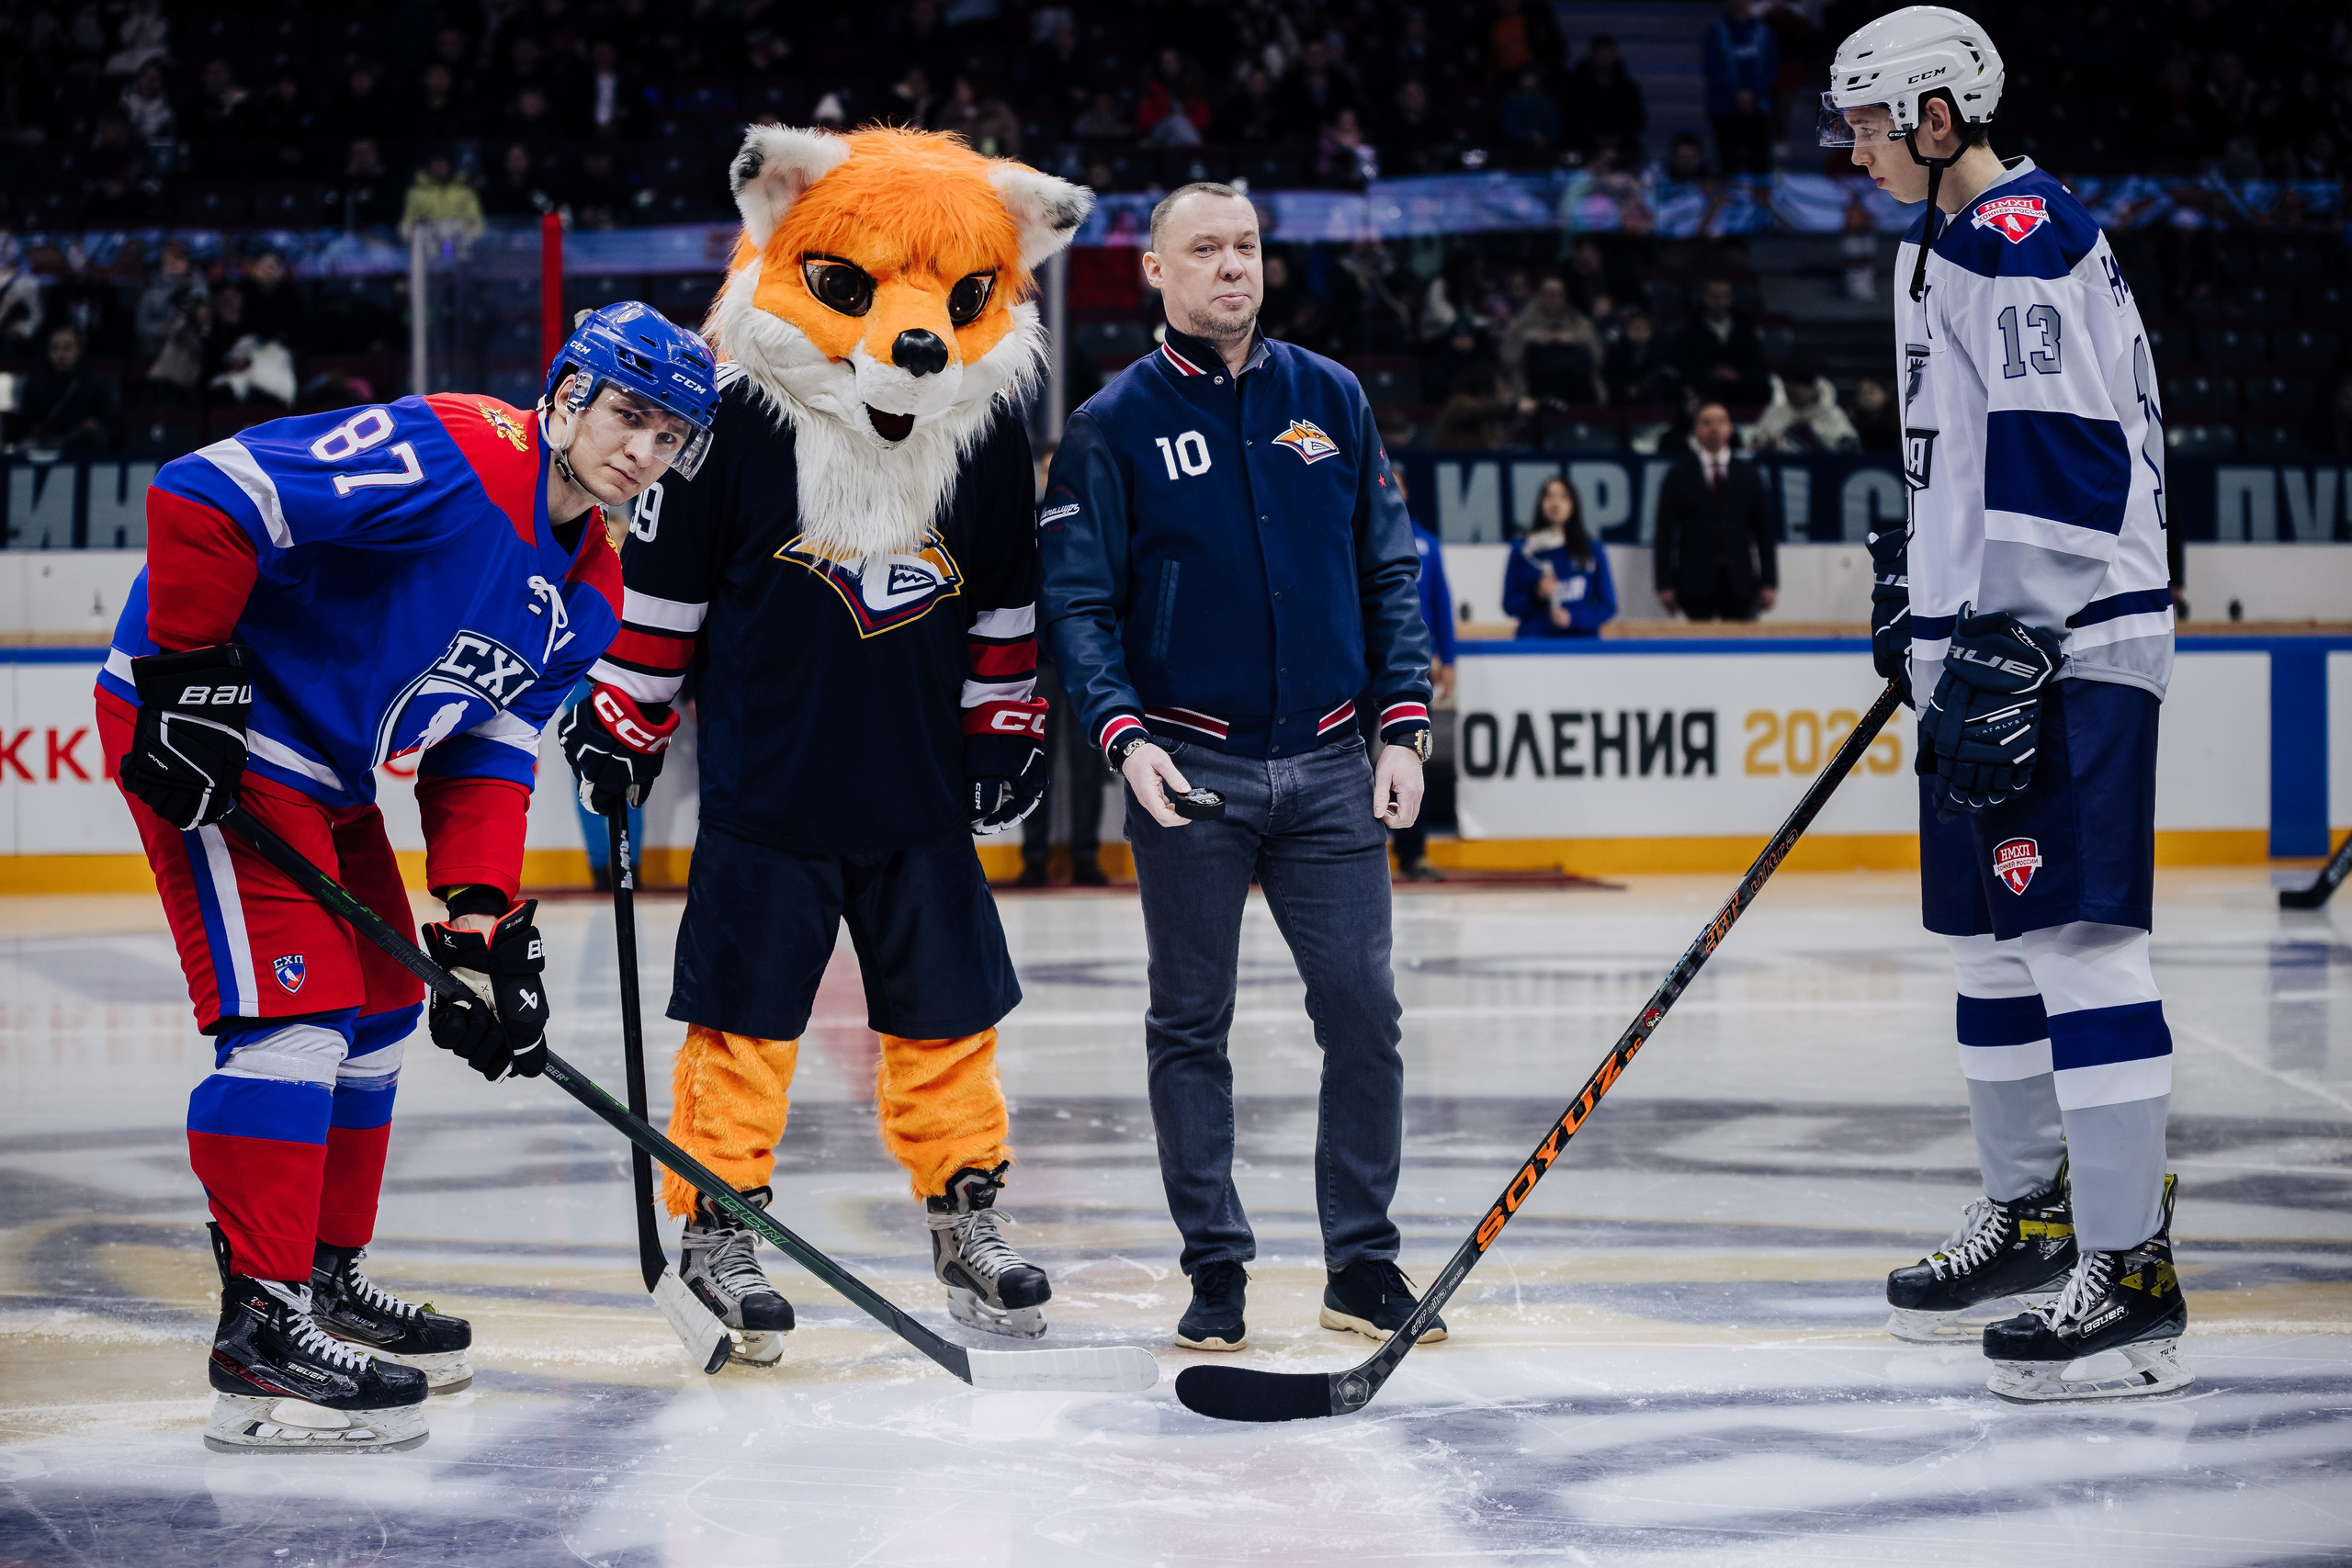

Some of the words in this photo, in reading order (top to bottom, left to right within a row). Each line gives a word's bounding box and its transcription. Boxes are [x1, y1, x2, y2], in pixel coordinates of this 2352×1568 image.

[1907, 66, 1946, 85] CCM
[1985, 199, 2035, 211] НМХЛ
[2013, 208, 2048, 218] РОССИИ
[569, 340, 592, 355] CCM
[1997, 304, 2062, 379] 13
[671, 372, 707, 395] CCM
[310, 408, 424, 495] 87
[1155, 430, 1213, 480] 10
[2216, 467, 2352, 542] ПУ
[1462, 710, 1717, 779] ОЛЕНИЯ
[1743, 709, 1904, 777] 2025
[2000, 844, 2030, 861] НМХЛ
[1476, 1051, 1623, 1253] SOYUZ
[718, 1194, 790, 1247] CCM
